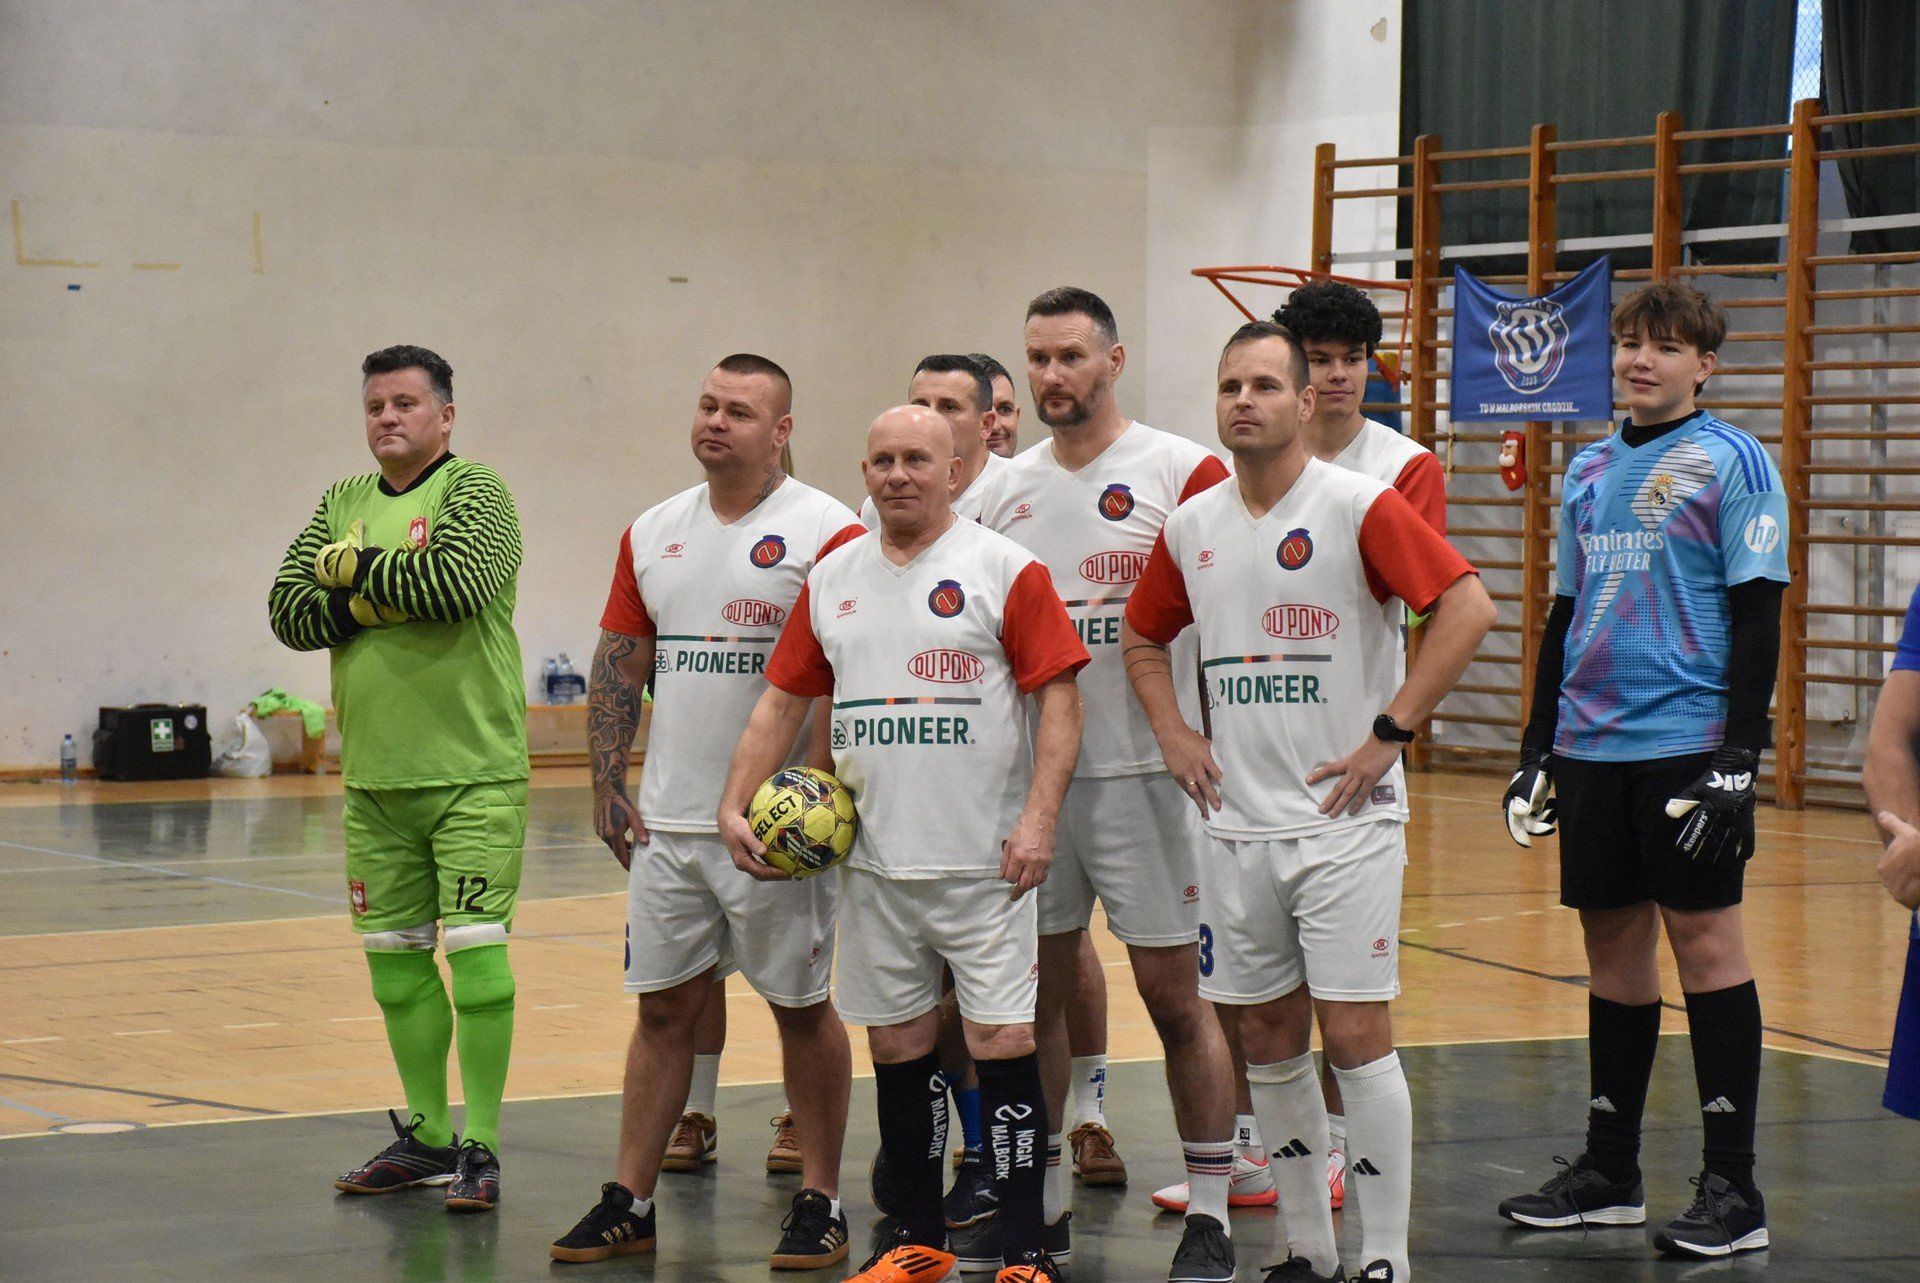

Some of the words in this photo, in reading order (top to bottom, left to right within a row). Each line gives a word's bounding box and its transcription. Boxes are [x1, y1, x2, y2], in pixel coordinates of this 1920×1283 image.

[1579, 529, 1664, 556] Emirates
[676, 651, 765, 673] PIONEER
[855, 717, 969, 746] PIONEER
[754, 795, 797, 841] SELECT
[455, 876, 487, 912] 12
[928, 1098, 949, 1160] MALBORK
[991, 1124, 1010, 1181] MALBORK
[1016, 1129, 1036, 1169] NOGAT
